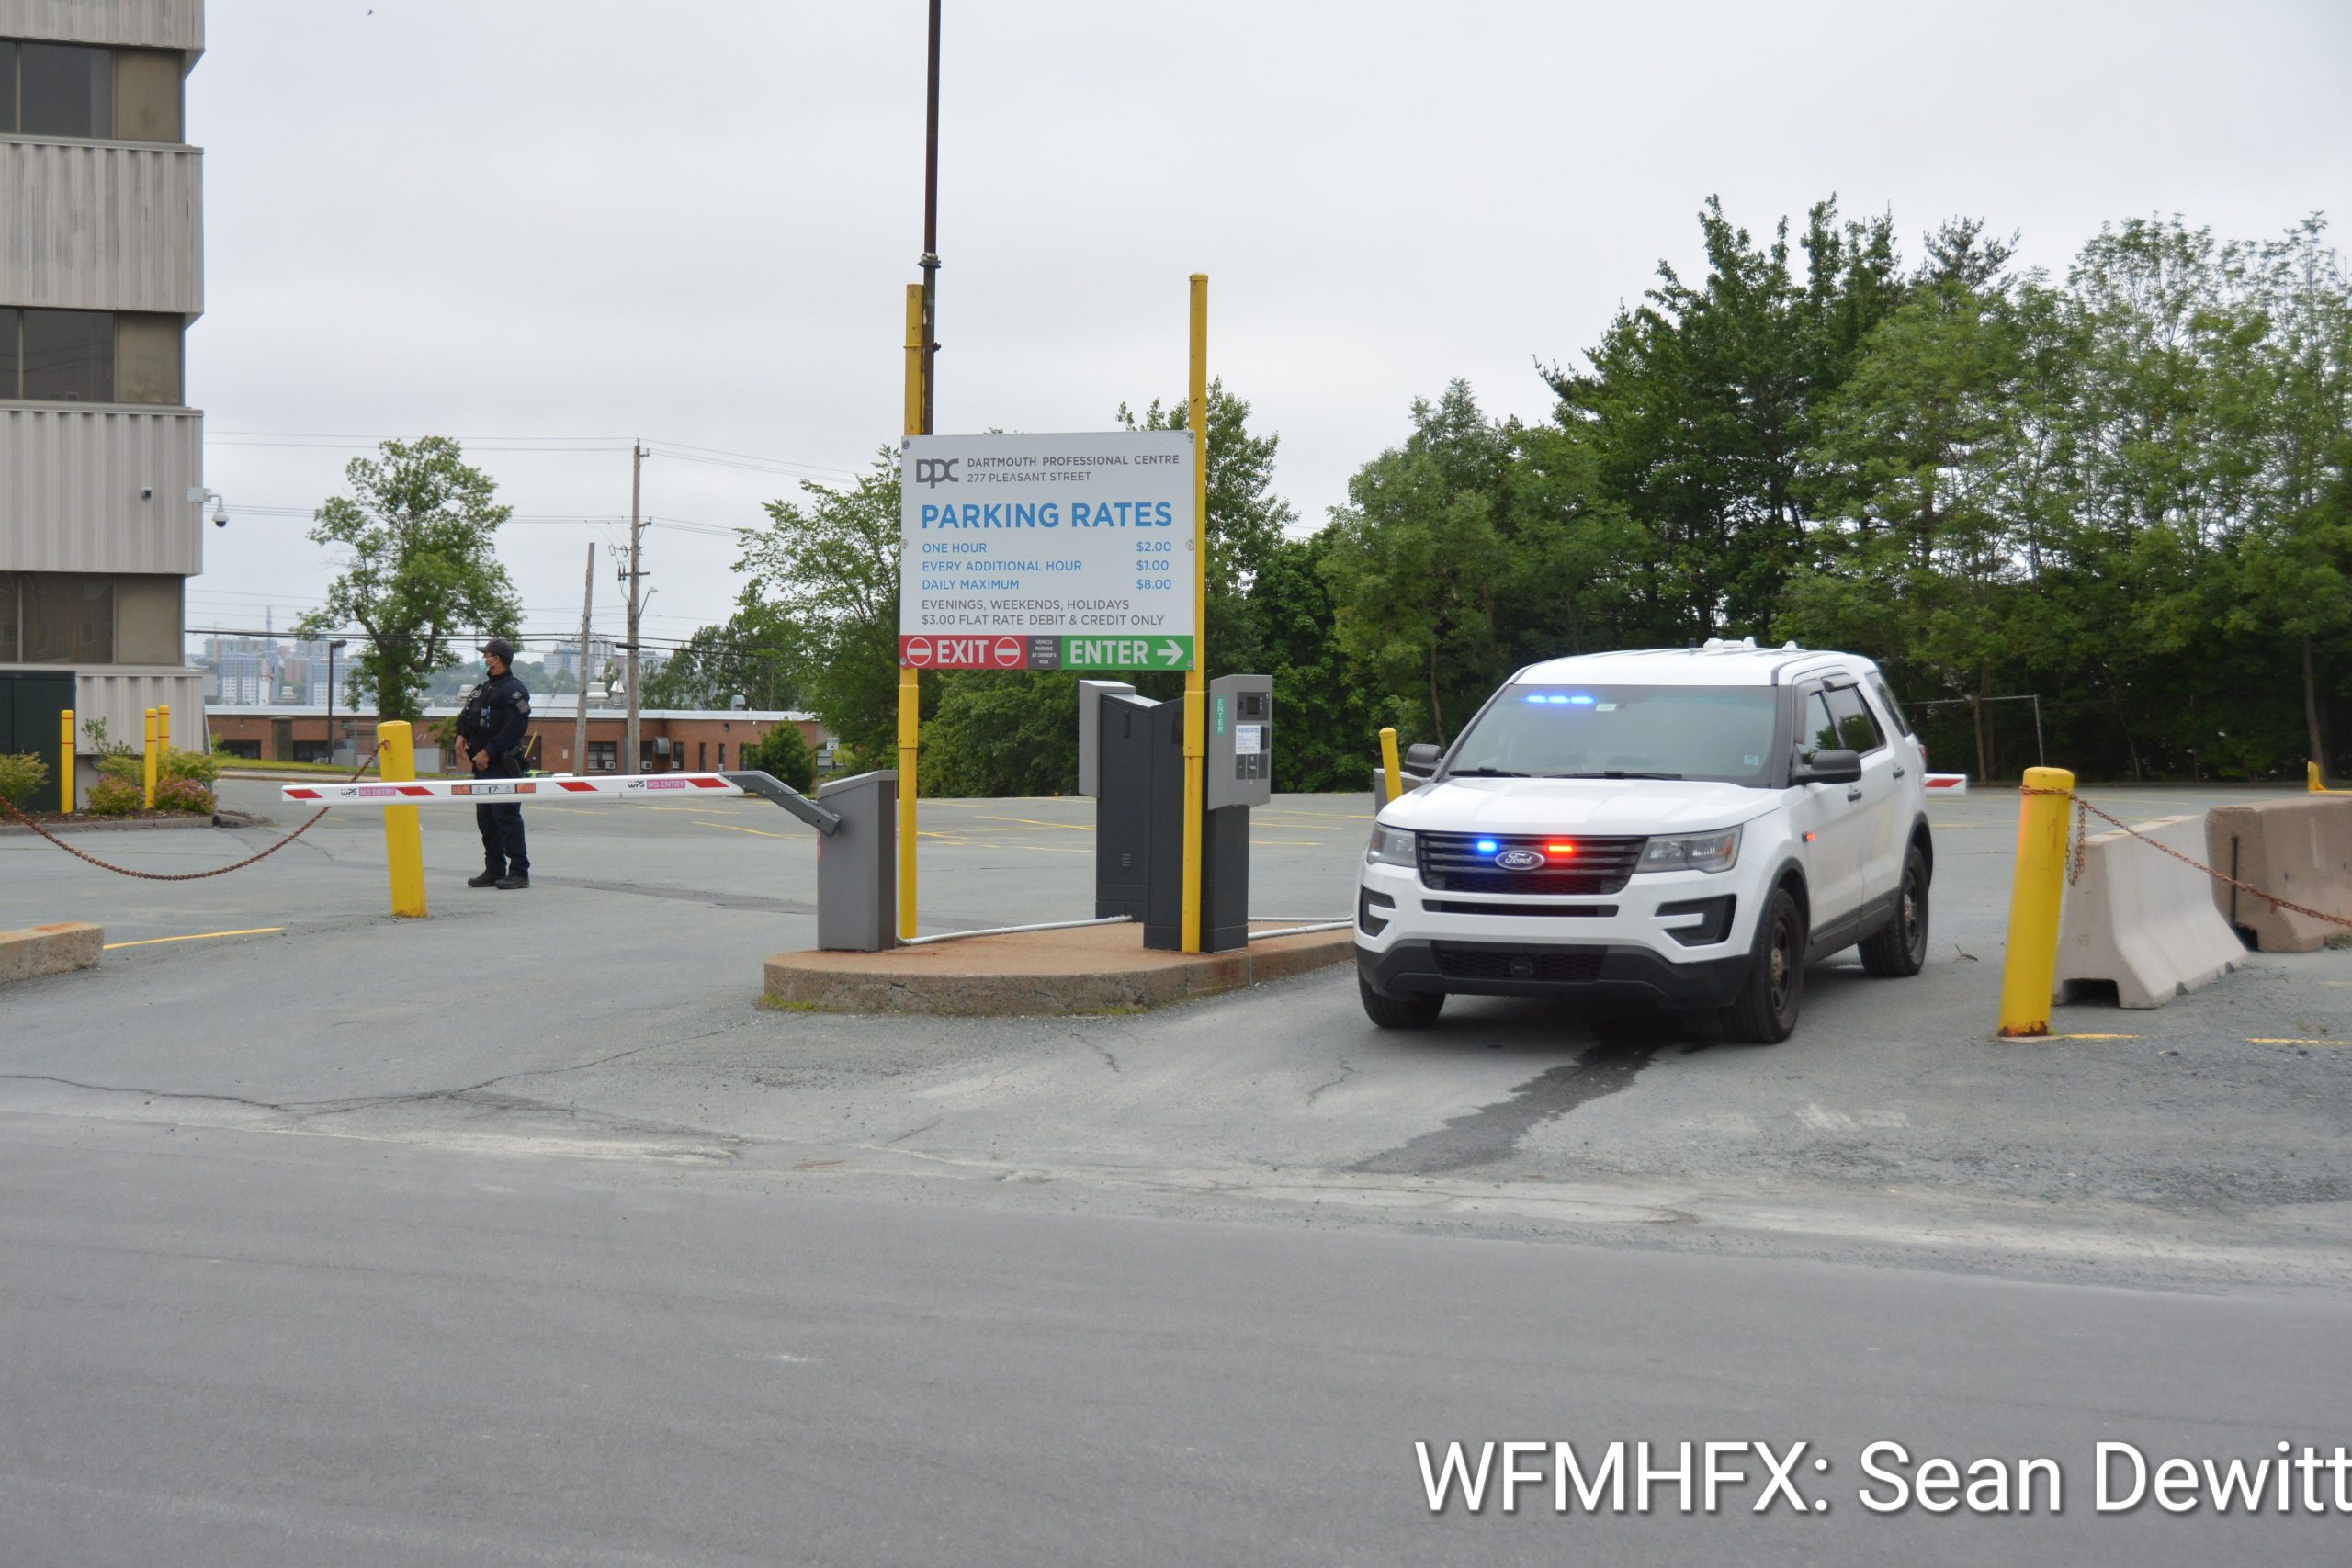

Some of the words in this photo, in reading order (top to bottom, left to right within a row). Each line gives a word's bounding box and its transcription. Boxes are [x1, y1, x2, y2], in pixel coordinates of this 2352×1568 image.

[967, 457, 1036, 468] DARTMOUTH
[1043, 456, 1129, 467] PROFESSIONAL
[1134, 455, 1180, 465] CENTRE
[967, 473, 985, 483] 277
[989, 472, 1046, 482] PLEASANT
[1050, 471, 1091, 481] STREET
[922, 502, 1059, 529] PARKING
[1071, 502, 1172, 527] RATES
[922, 543, 948, 553] ONE
[952, 543, 987, 553] HOUR
[1136, 541, 1171, 553] $2.00
[922, 561, 962, 571] EVERY
[966, 560, 1042, 571] ADDITIONAL
[1046, 560, 1082, 571] HOUR
[1136, 559, 1169, 571] $1.00
[922, 580, 956, 590] DAILY
[960, 580, 1019, 590] MAXIMUM
[1136, 579, 1171, 591] $8.00
[922, 599, 987, 611] EVENINGS,
[990, 599, 1064, 611] WEEKENDS,
[1067, 599, 1129, 610] HOLIDAYS
[922, 615, 955, 626] $3.00
[959, 615, 989, 625] FLAT
[993, 615, 1023, 625] RATE
[1029, 615, 1066, 625] DEBIT
[1069, 615, 1078, 626] &
[1081, 615, 1127, 626] CREDIT
[1131, 615, 1165, 626] ONLY
[937, 639, 989, 663] EXIT
[1069, 640, 1148, 664] ENTER
[661, 780, 684, 788] ENTRY
[372, 787, 396, 795] ENTRY
[1505, 852, 1532, 864] Ford
